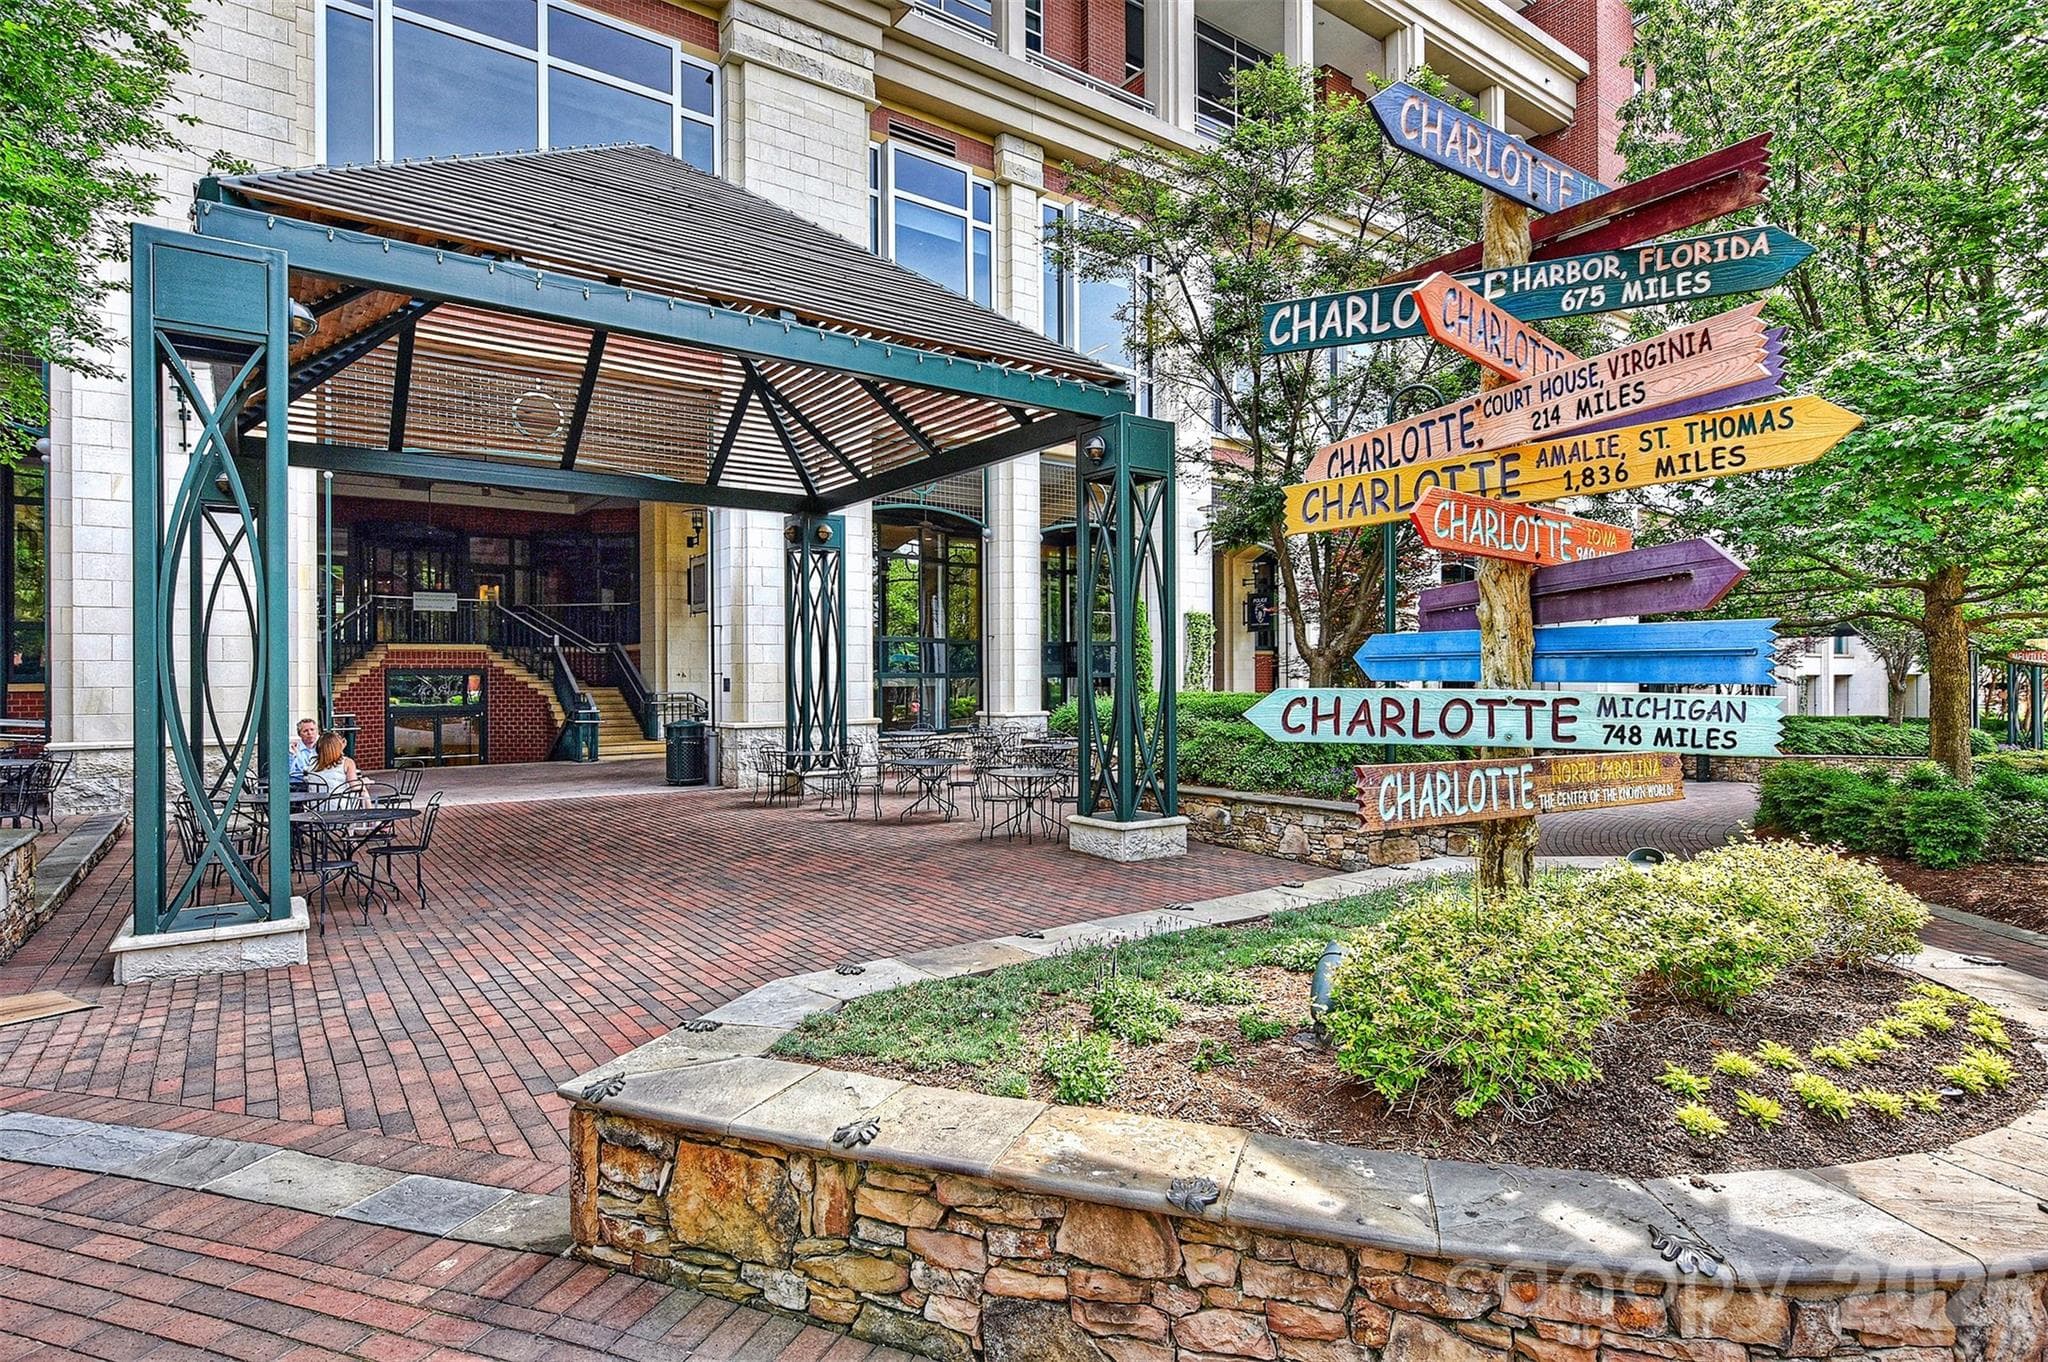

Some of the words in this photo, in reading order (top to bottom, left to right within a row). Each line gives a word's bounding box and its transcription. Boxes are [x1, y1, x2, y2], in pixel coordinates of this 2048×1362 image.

[1401, 95, 1574, 210] CHARLOTTE
[1269, 271, 1508, 346] CHARLOE
[1513, 255, 1627, 293] HARBOR,
[1639, 232, 1769, 275] FLORIDA
[1560, 285, 1605, 312] 675
[1621, 271, 1711, 304] MILES
[1483, 385, 1532, 419] COURT
[1540, 362, 1605, 403] HOUSE,
[1607, 327, 1713, 380] VIRGINIA
[1531, 405, 1561, 431] 214
[1576, 381, 1646, 420] MILES
[1302, 452, 1521, 524] CHARLOTTE
[1536, 434, 1627, 468] AMALIE,
[1638, 427, 1671, 452] ST.
[1684, 407, 1795, 444] THOMAS
[1563, 463, 1629, 494] 1,836
[1655, 445, 1747, 479] MILES
[1433, 499, 1573, 561] CHARLOTTE
[1585, 527, 1618, 548] IOWA
[1281, 696, 1580, 743] CHARLOTTE
[1596, 696, 1747, 723] MICHIGAN
[1602, 724, 1642, 745] 748
[1653, 727, 1738, 749] MILES
[1378, 763, 1534, 822] CHARLOTTE
[1551, 761, 1595, 785] NORTH
[1600, 758, 1662, 781] CAROLINA
[1538, 793, 1554, 809] THE
[1556, 789, 1589, 807] CENTER
[1590, 788, 1601, 803] OF
[1602, 786, 1617, 801] THE
[1618, 785, 1646, 800] KNOWN
